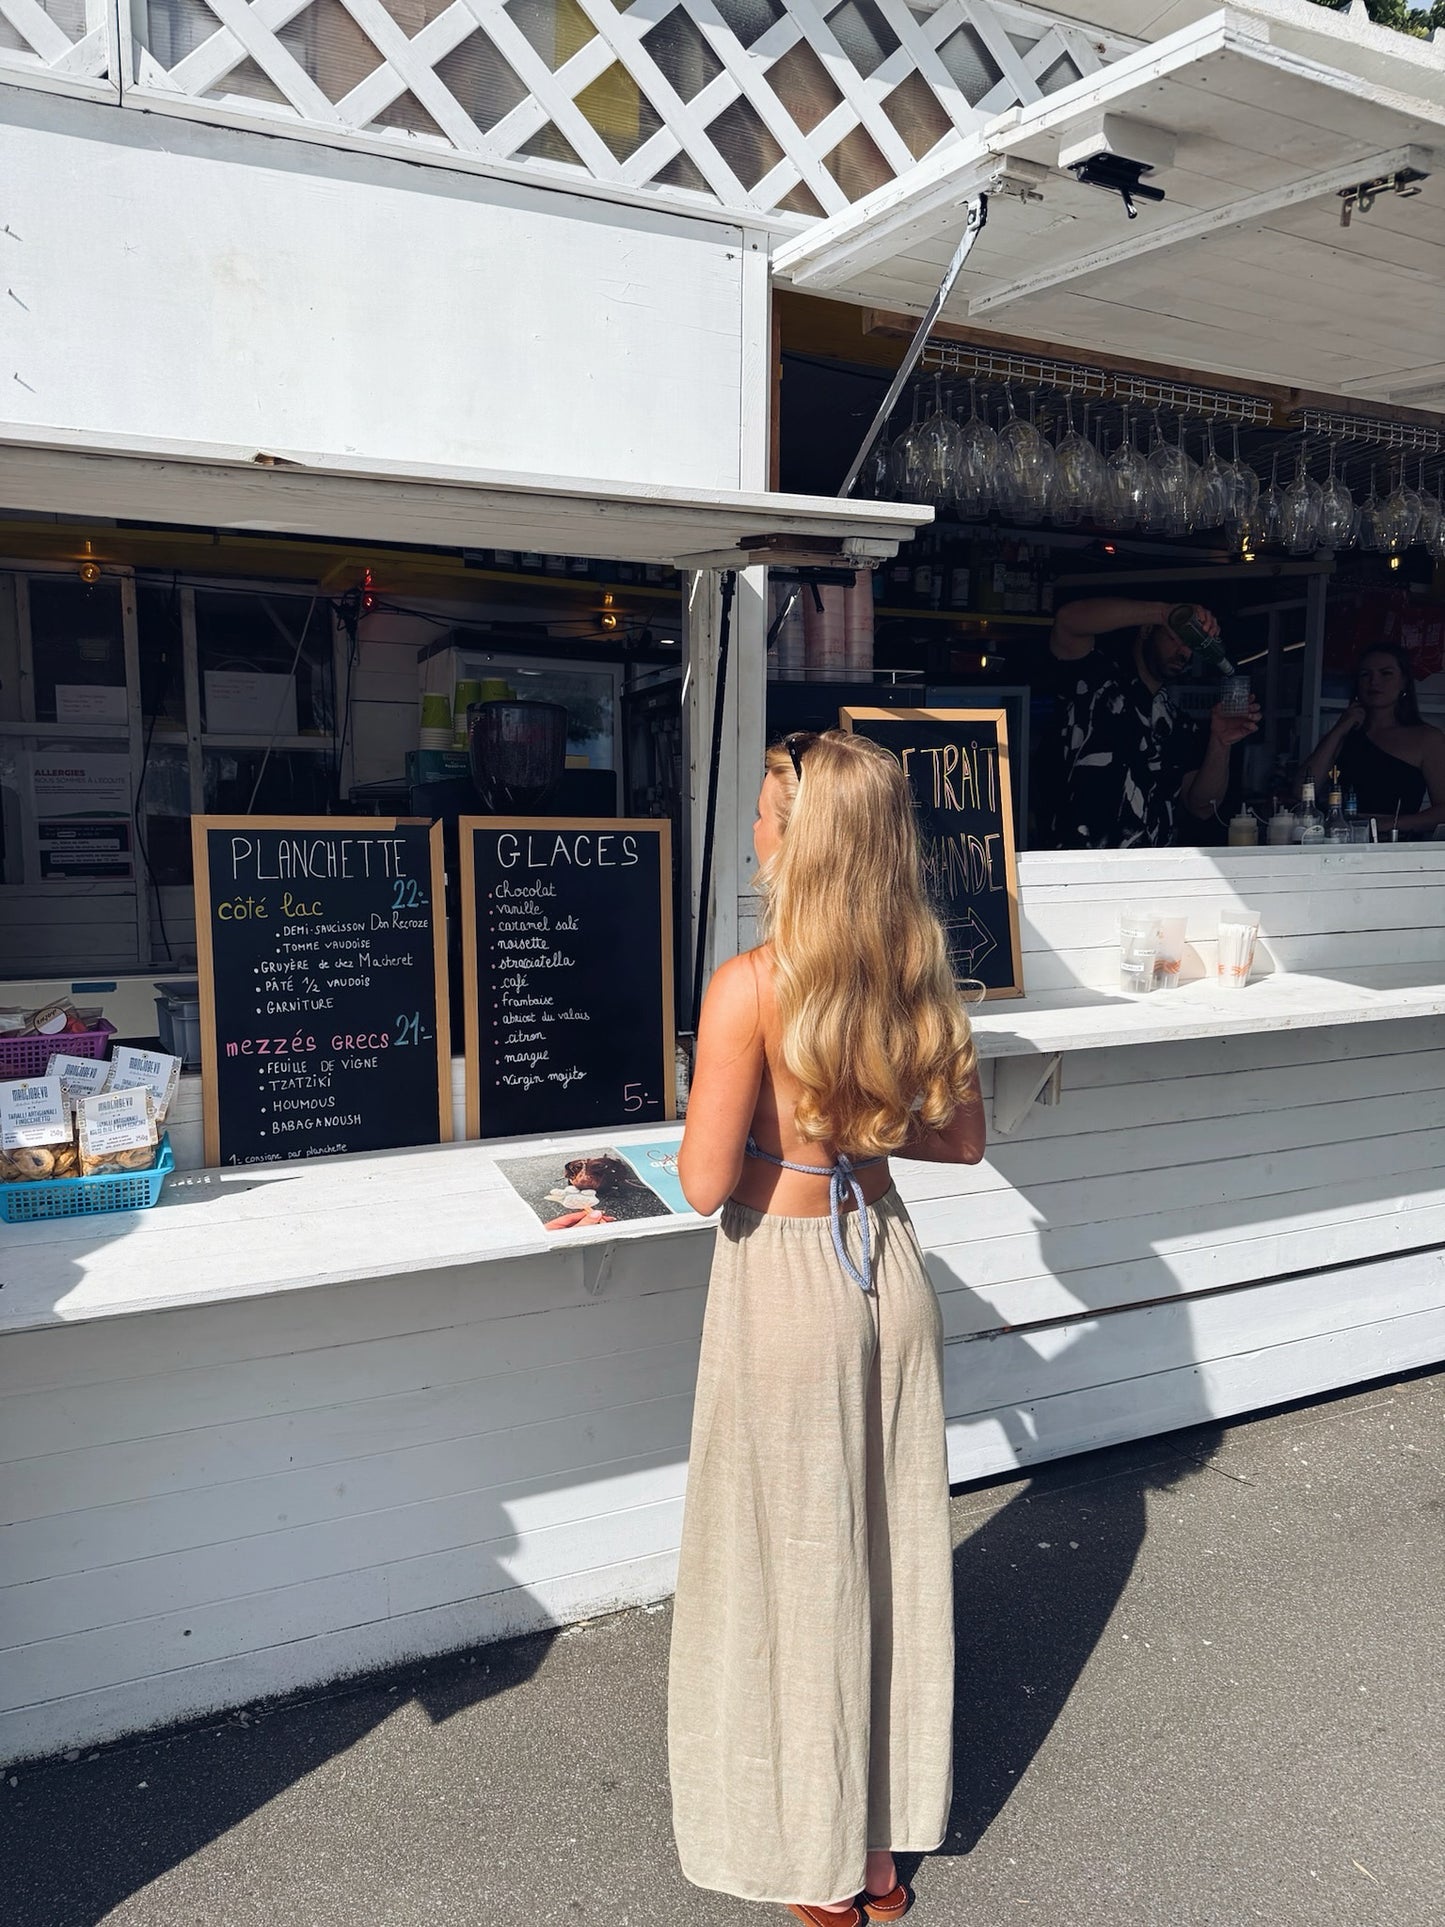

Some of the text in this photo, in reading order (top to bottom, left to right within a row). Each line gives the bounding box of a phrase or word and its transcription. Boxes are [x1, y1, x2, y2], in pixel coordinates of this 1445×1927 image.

[34, 769, 86, 777] ALLERGIES
[232, 837, 407, 880] PLANCHETTE
[497, 833, 639, 868] GLACES
[218, 892, 324, 920] côté lac
[496, 900, 544, 915] vanille
[498, 915, 580, 932] caramel salé
[283, 941, 320, 953] TOMME
[497, 937, 550, 950] noisette
[318, 959, 330, 969] de
[335, 957, 354, 969] chez
[498, 950, 575, 969] stracciatella
[265, 976, 295, 993] PÂTÉ
[302, 977, 321, 993] 1/2
[500, 973, 529, 994] café
[502, 1008, 591, 1024] abricot du valais
[226, 1029, 317, 1057] mezzés
[505, 1030, 547, 1044] citron
[321, 1060, 335, 1072] DE
[504, 1050, 550, 1068] mangue
[548, 1065, 588, 1089] mojito
[273, 1096, 336, 1113] HOUMOUS
[272, 1114, 362, 1134] BABAGANOUSH
[245, 1152, 282, 1164] consigne
[288, 1150, 302, 1160] par
[306, 1143, 347, 1157] planchette
